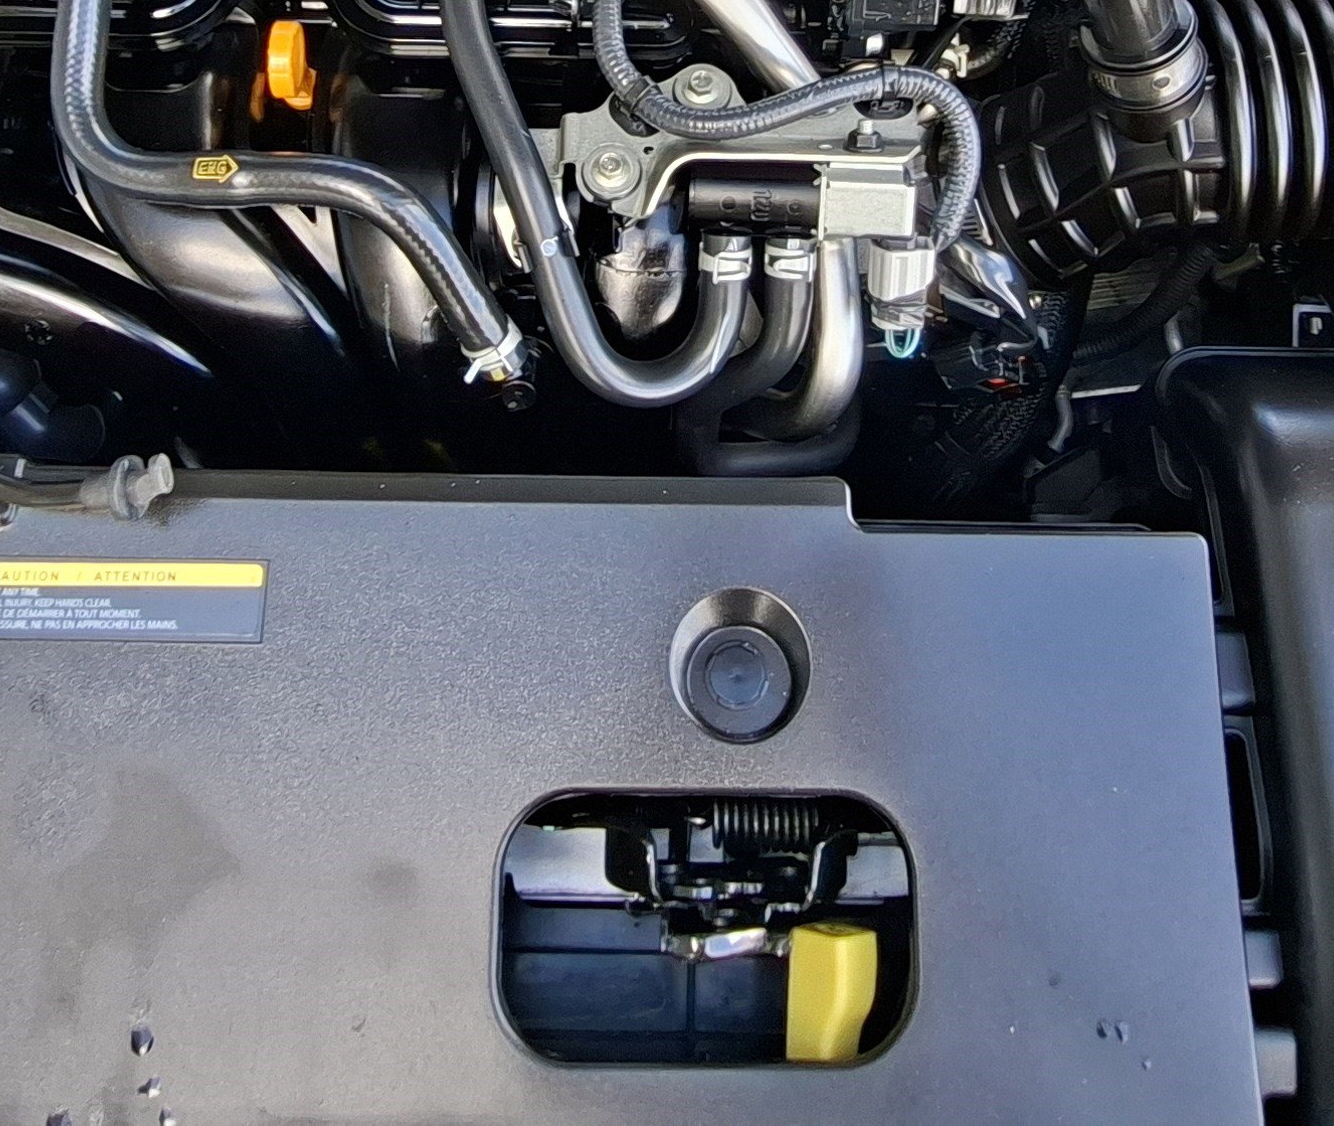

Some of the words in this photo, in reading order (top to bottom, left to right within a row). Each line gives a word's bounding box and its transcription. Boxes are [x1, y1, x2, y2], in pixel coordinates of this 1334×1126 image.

[93, 570, 177, 582] ATTENTION
[34, 598, 54, 607] KEEP
[55, 598, 83, 607] HANDS
[3, 608, 15, 618] DE
[75, 608, 98, 618] TOUT
[30, 619, 43, 629] NE
[44, 619, 61, 629] PAS
[62, 619, 75, 629] EN
[76, 619, 129, 629] APPROCHER
[130, 619, 146, 629] LES
